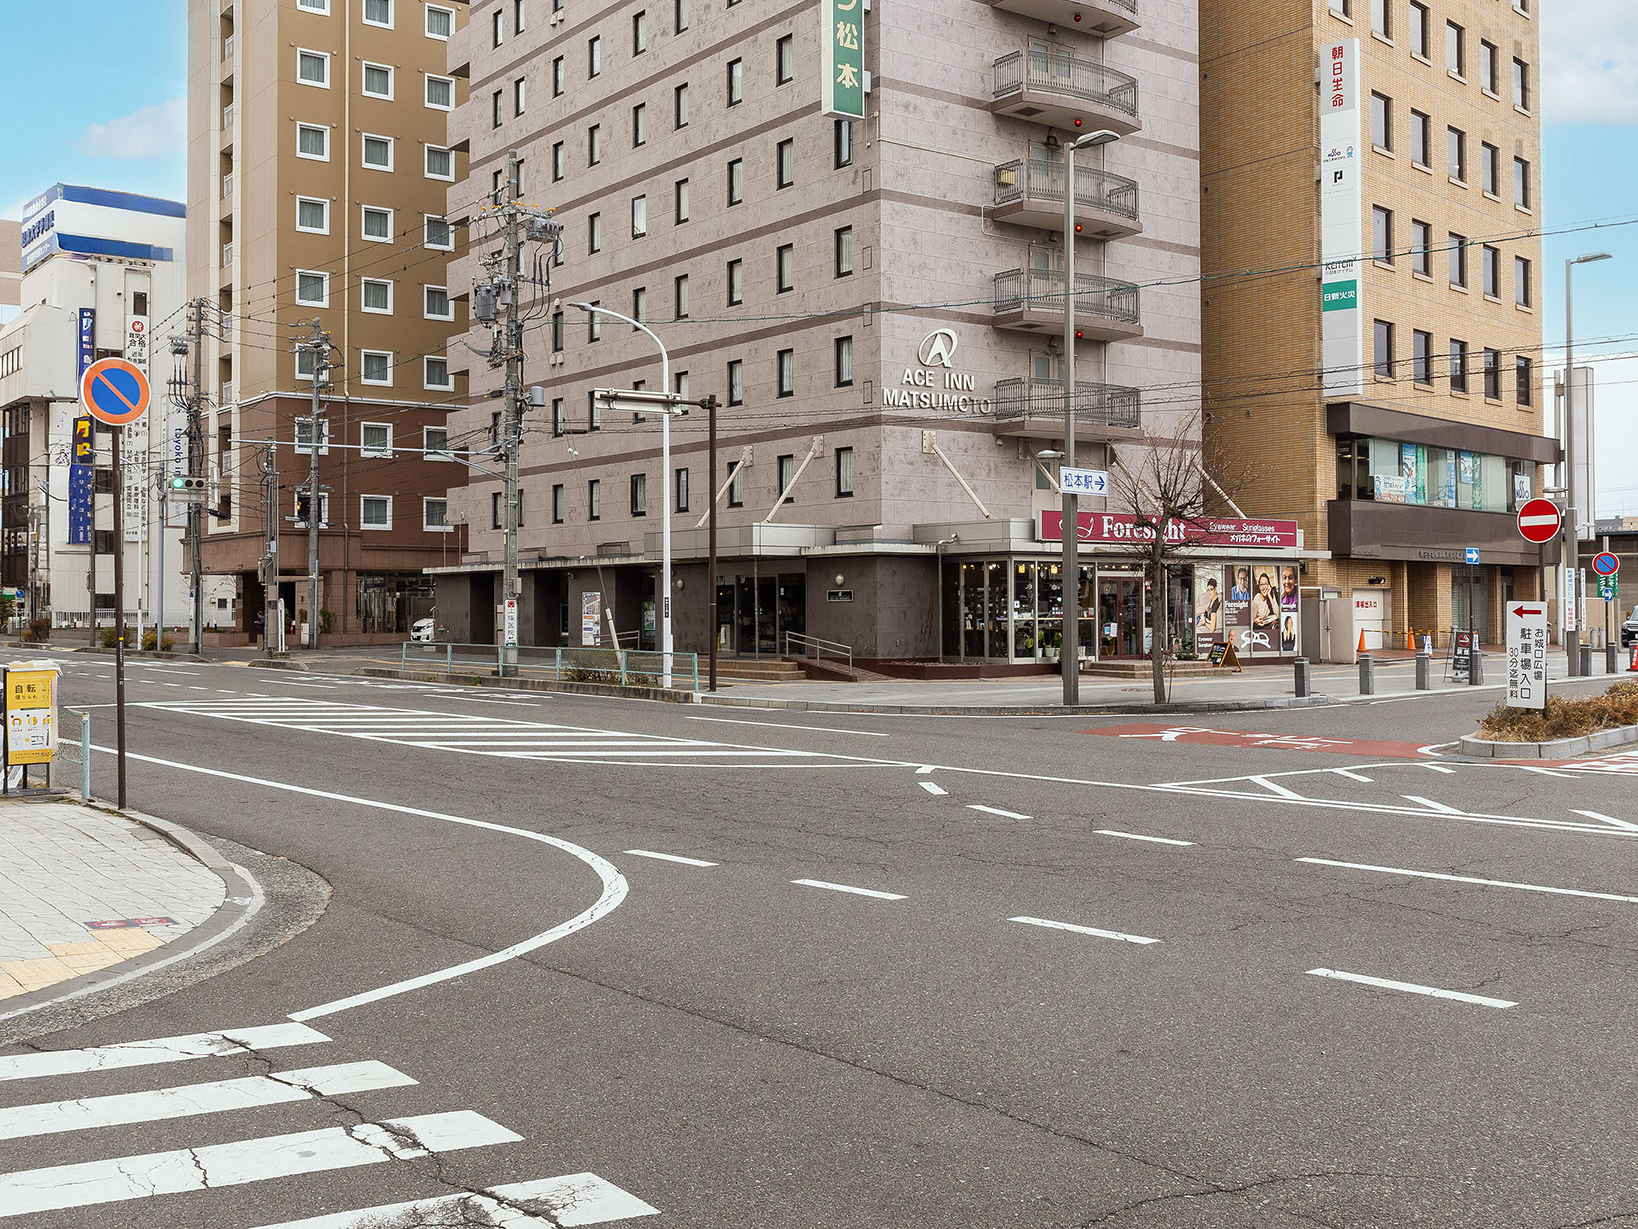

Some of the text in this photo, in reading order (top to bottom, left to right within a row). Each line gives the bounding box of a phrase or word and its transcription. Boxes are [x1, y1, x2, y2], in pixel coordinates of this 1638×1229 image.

[1331, 45, 1344, 108] 朝日生命
[1324, 290, 1356, 302] 日新火災
[129, 339, 146, 348] 合格
[901, 368, 975, 392] ACE INN
[881, 388, 992, 414] MATSUMOTO
[174, 427, 183, 463] toyoko
[1063, 472, 1094, 490] 松本駅
[1242, 522, 1276, 533] Sunglasses
[1520, 627, 1532, 699] 駐車場入口
[1533, 628, 1544, 681] お城口広場
[1509, 647, 1519, 699] 30分迄無料
